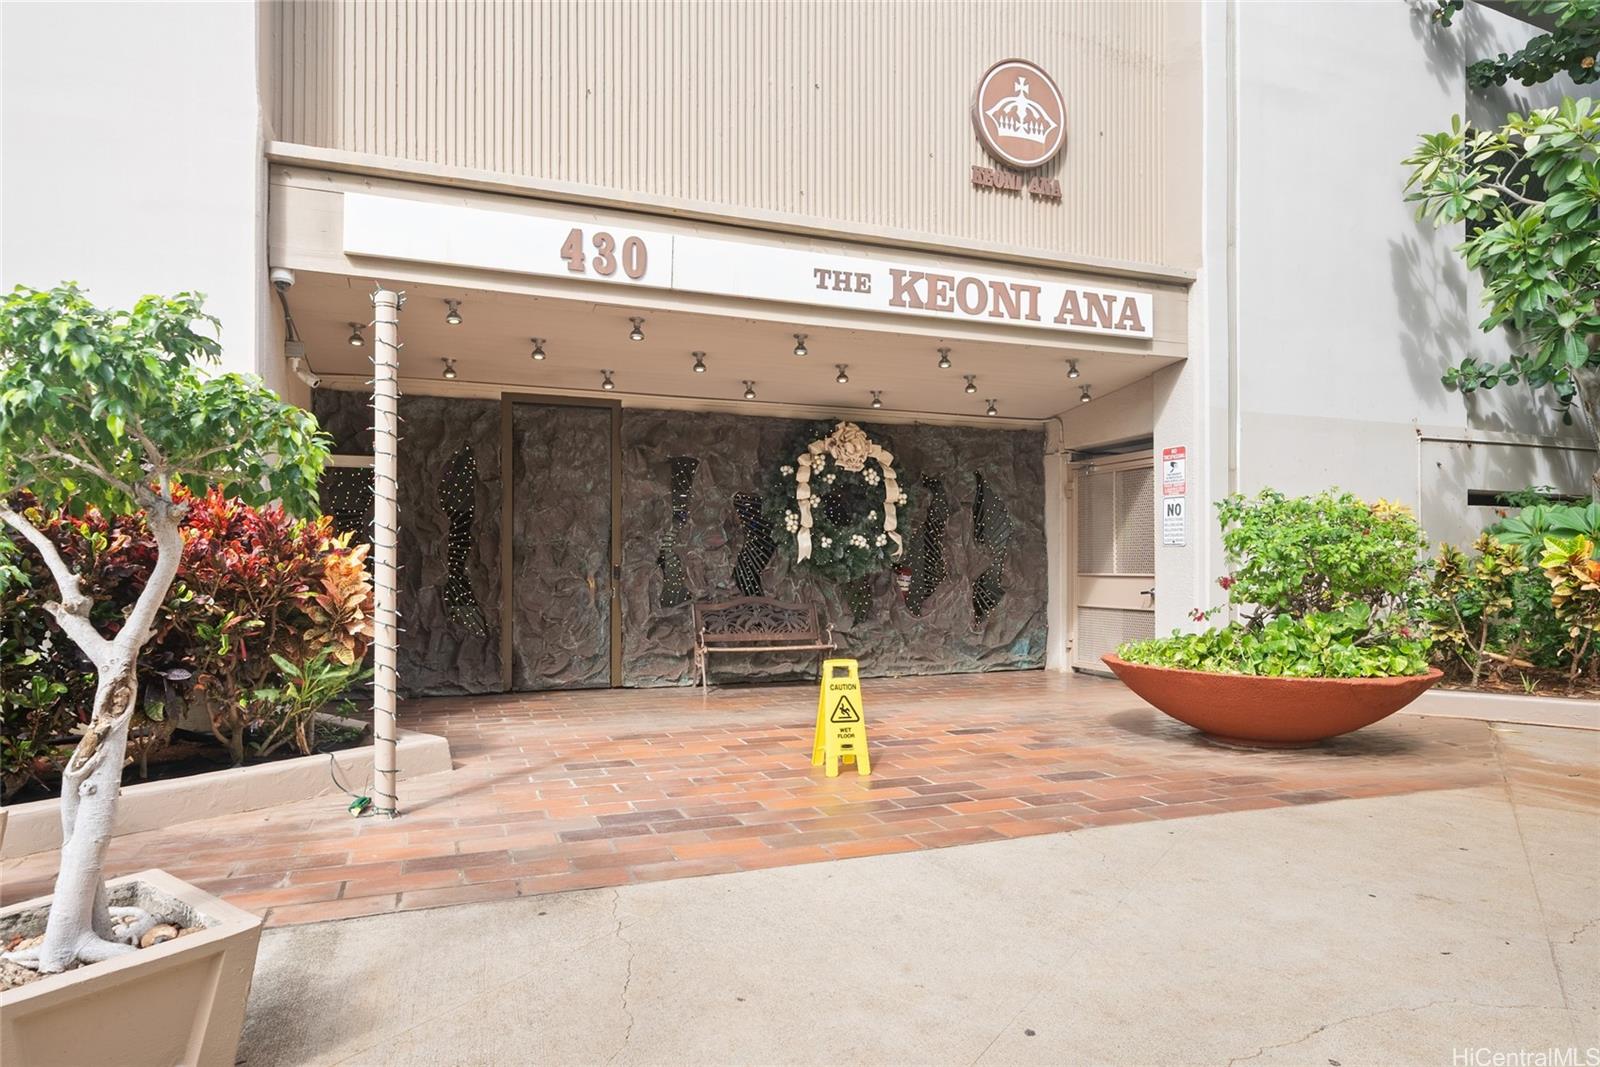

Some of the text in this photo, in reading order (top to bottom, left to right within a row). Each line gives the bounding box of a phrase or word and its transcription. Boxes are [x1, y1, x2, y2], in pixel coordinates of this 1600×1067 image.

[972, 165, 1062, 198] KEONI ANA
[560, 228, 648, 279] 430
[813, 268, 1145, 332] THE KEONI ANA
[1167, 503, 1181, 516] NO
[829, 683, 857, 691] CAUTION
